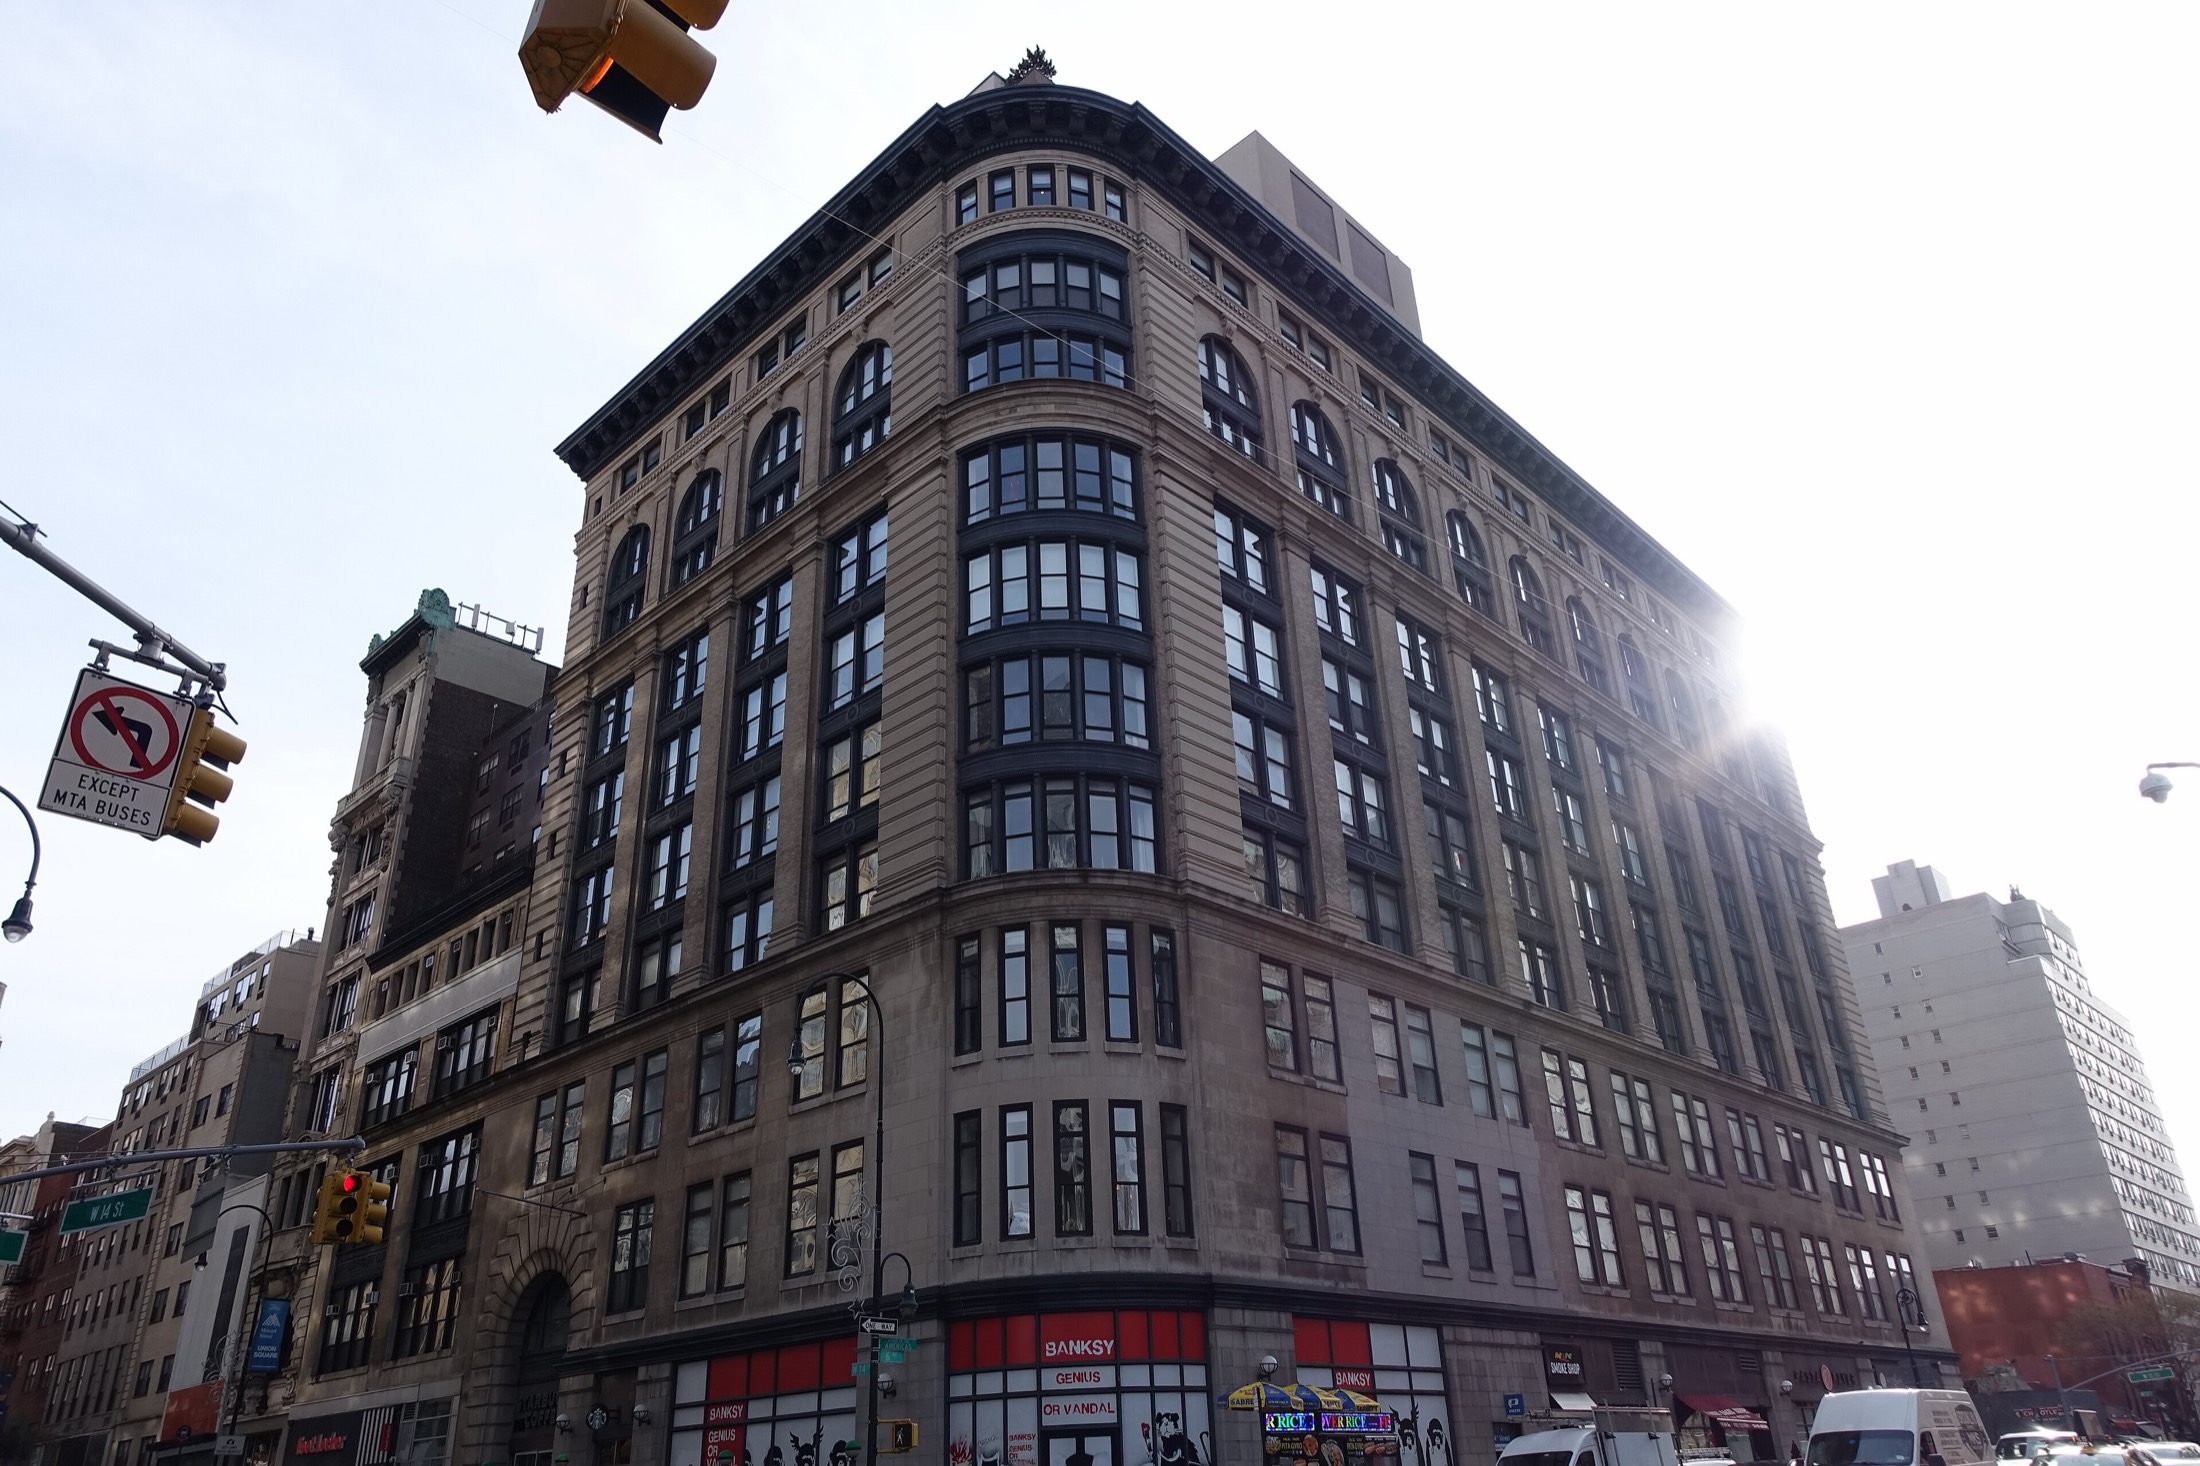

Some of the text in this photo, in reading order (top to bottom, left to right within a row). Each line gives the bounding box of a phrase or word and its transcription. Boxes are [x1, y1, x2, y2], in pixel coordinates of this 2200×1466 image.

[78, 774, 140, 802] EXCEPT
[53, 789, 87, 811] MTA
[95, 799, 151, 826] BUSES
[89, 1200, 125, 1222] W 14 St
[865, 1321, 893, 1331] ONE WAY
[884, 1342, 912, 1351] AMERICAS
[1045, 1339, 1115, 1357] BANKSY
[253, 1351, 278, 1359] SQUARE
[885, 1351, 891, 1361] 6
[1550, 1361, 1580, 1376] SMOKE SHOP
[1055, 1371, 1102, 1385] GENIUS
[1335, 1371, 1371, 1387] BANKSY
[514, 1391, 559, 1413] STARBU
[1043, 1401, 1116, 1416] OR VANDAL
[524, 1408, 557, 1427] COFFE
[710, 1404, 744, 1421] BANKSY
[1277, 1416, 1307, 1428] RICE
[1345, 1416, 1367, 1428] RICE
[708, 1429, 736, 1443] GENIUS
[1009, 1433, 1037, 1441] BANKSY
[707, 1444, 718, 1457] OR
[1009, 1444, 1033, 1453] GENIUS
[1281, 1442, 1303, 1450] PITA GYRO
[1009, 1452, 1018, 1460] OR
